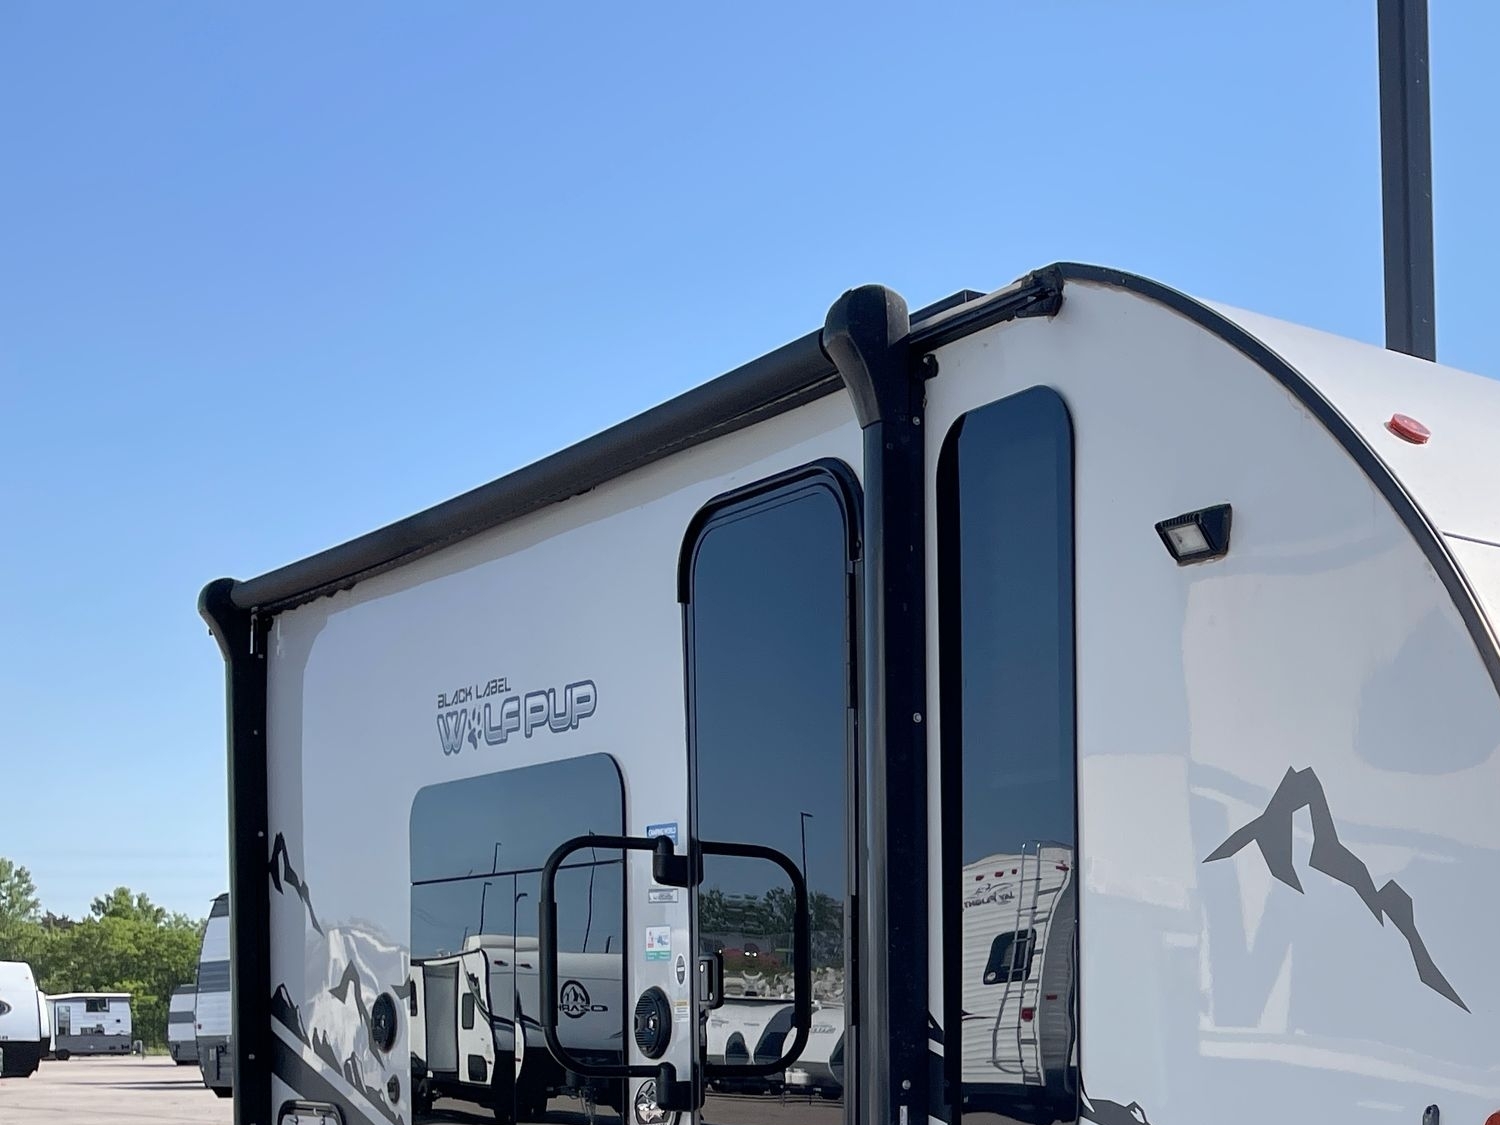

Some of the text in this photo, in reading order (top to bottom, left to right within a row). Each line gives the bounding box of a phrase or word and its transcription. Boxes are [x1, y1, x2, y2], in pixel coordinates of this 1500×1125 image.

[437, 677, 512, 709] BLACK LABEL
[524, 679, 597, 739] PUP
